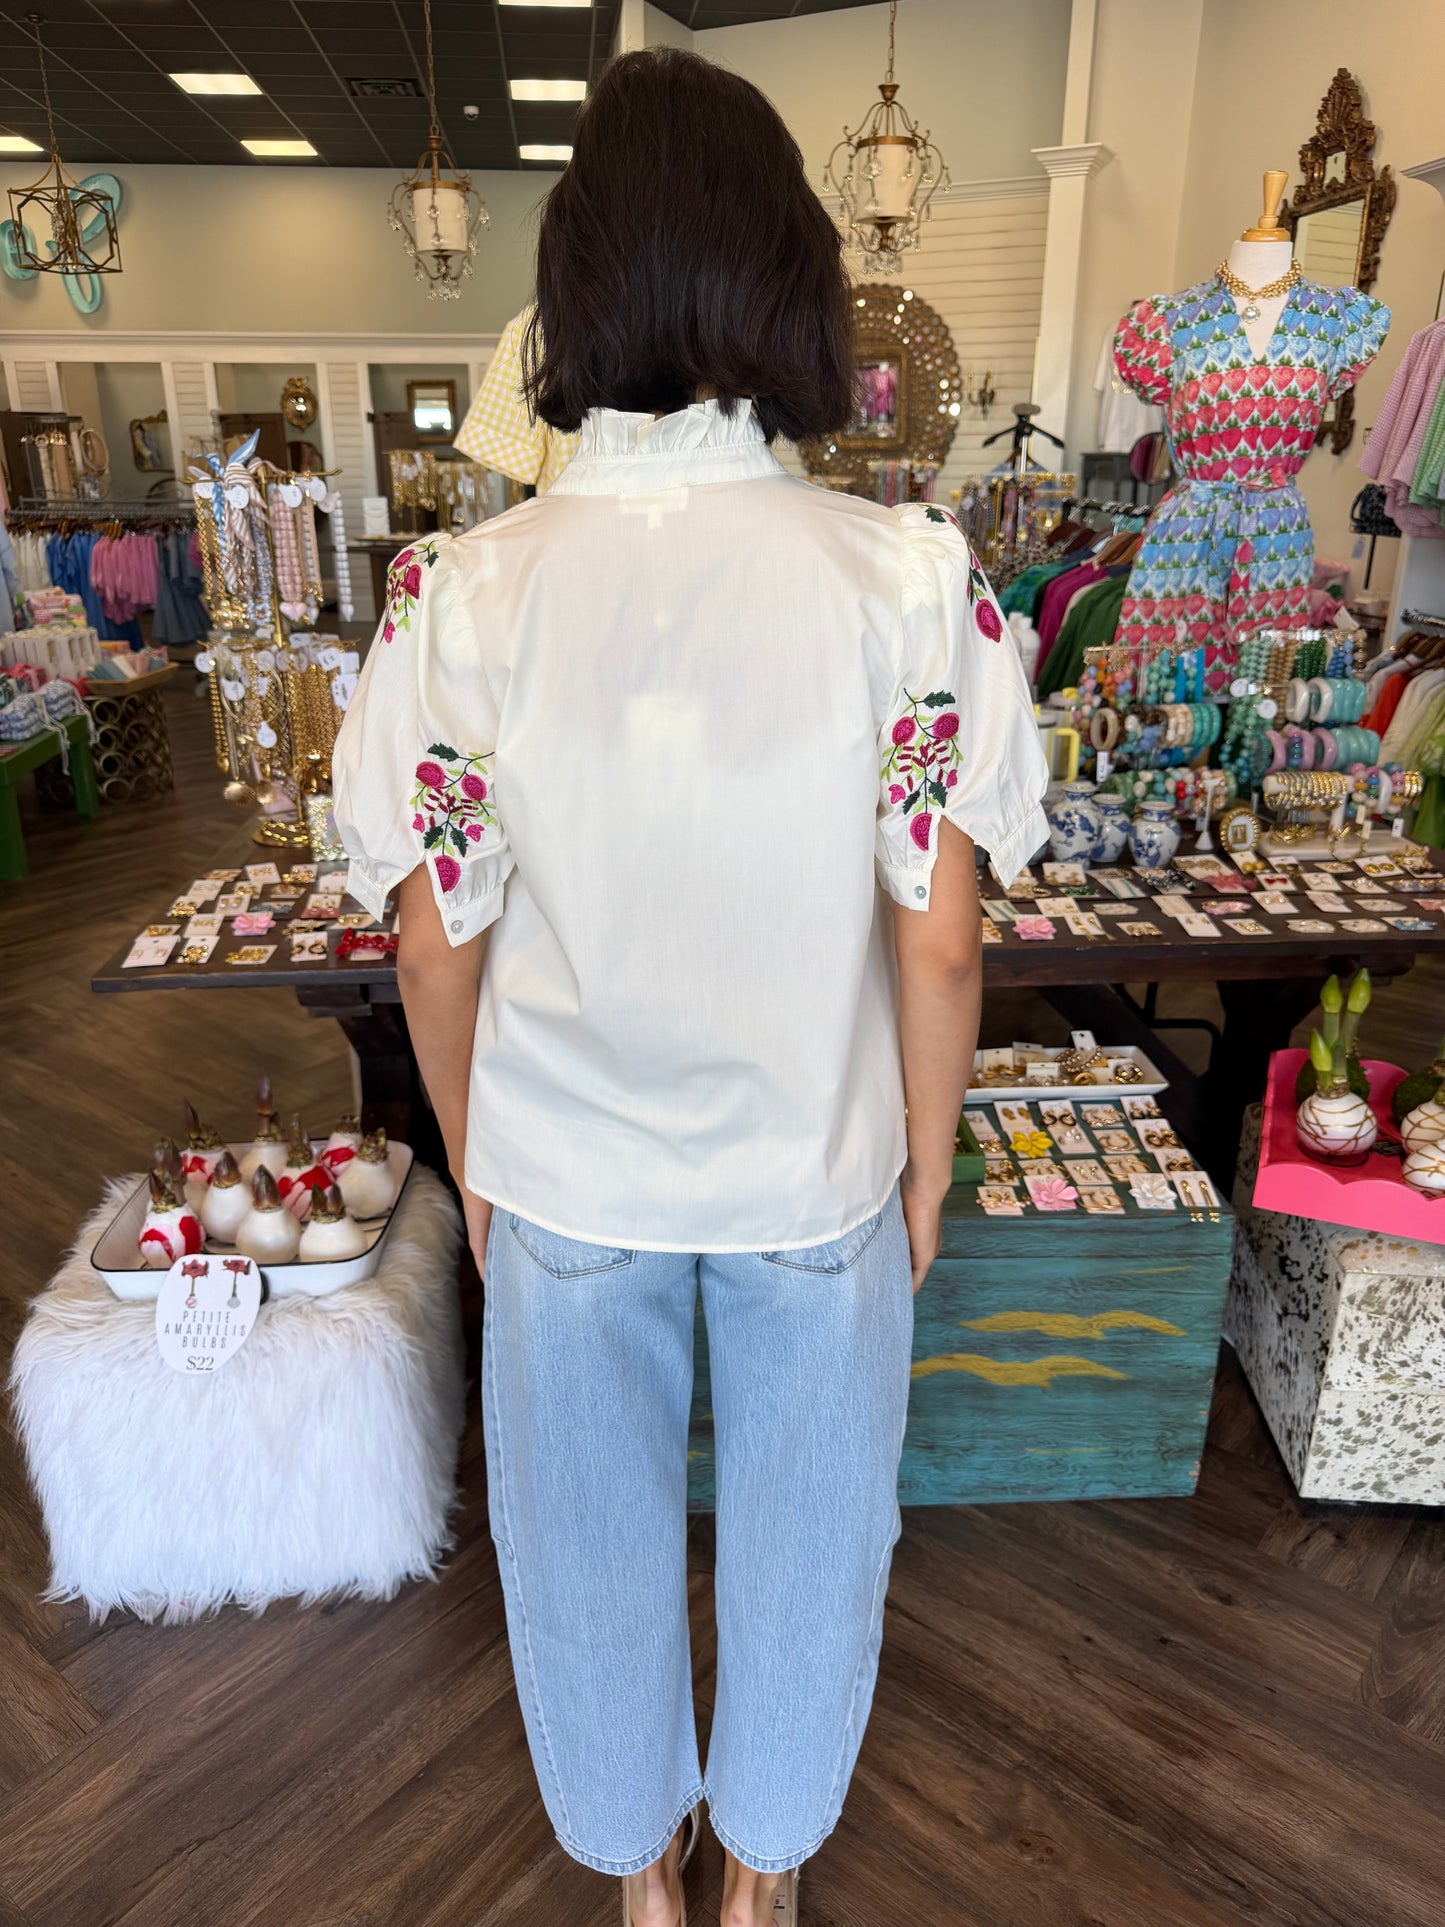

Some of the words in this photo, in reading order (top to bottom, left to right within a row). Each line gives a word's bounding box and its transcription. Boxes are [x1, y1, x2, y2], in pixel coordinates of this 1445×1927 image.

[183, 1311, 231, 1323] PETITE
[164, 1323, 246, 1336] AMARYLLIS
[182, 1336, 227, 1348] BULBS
